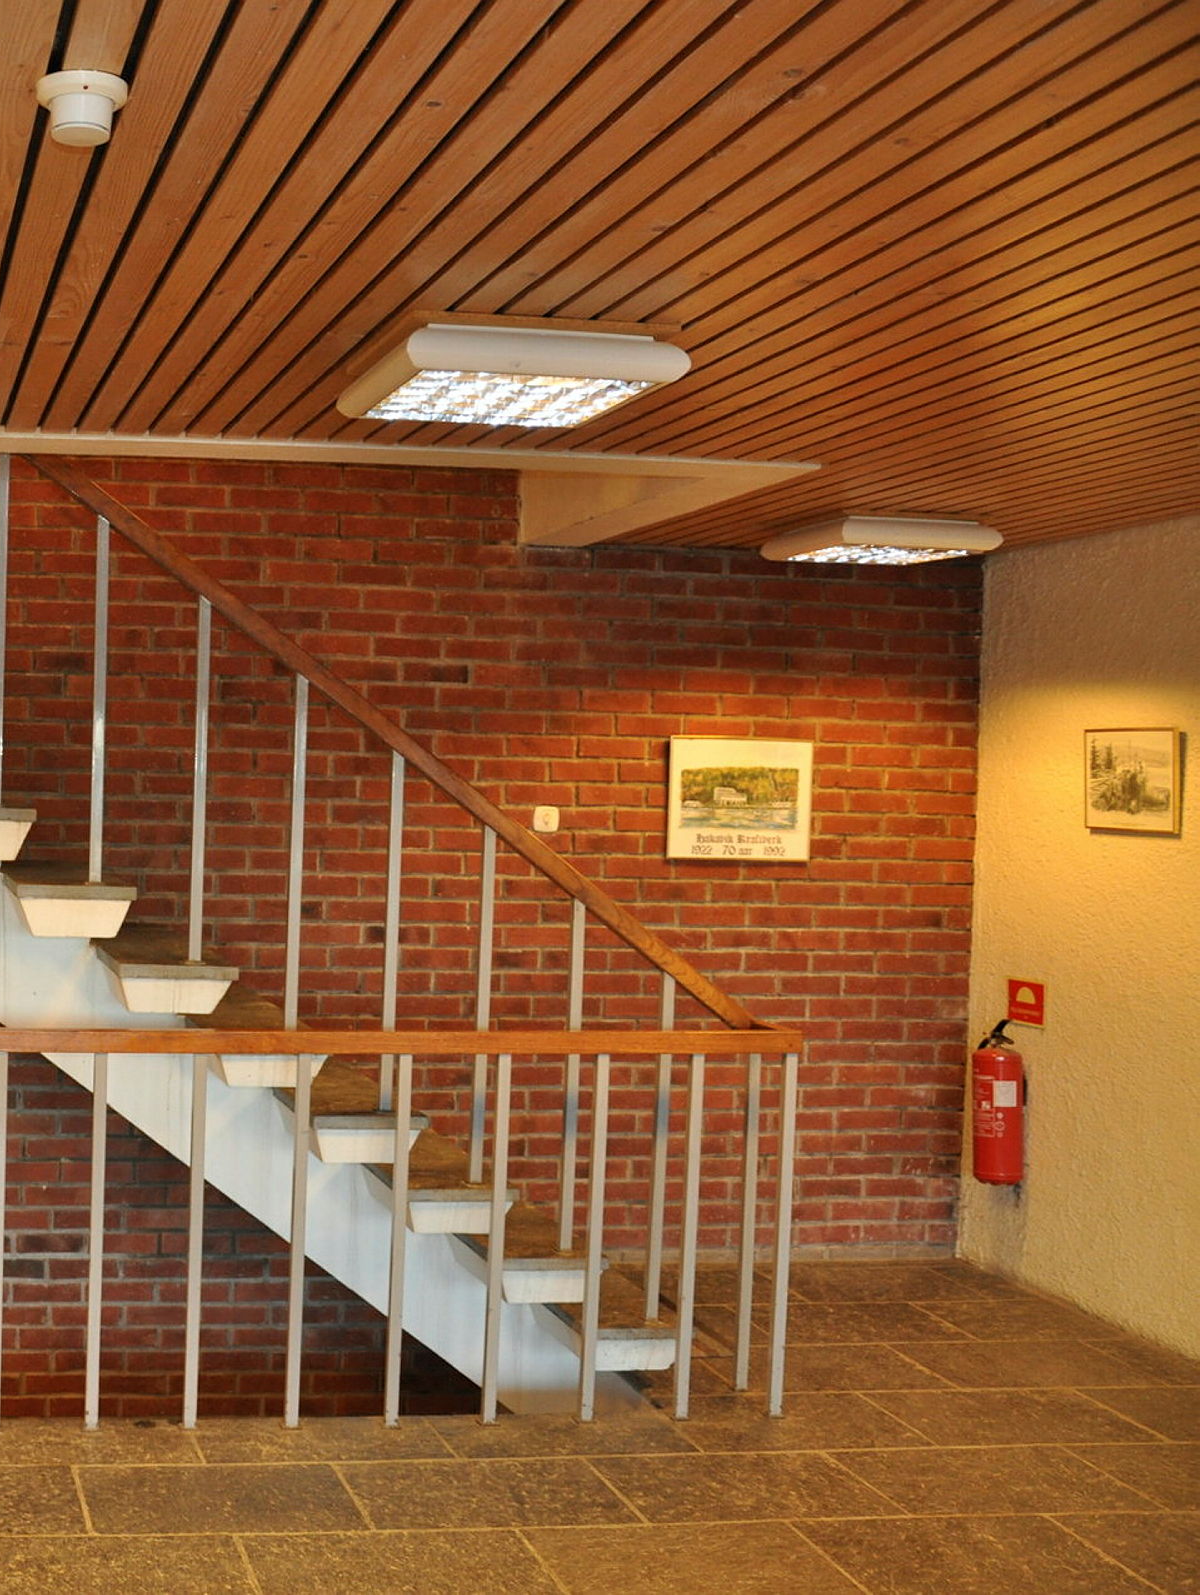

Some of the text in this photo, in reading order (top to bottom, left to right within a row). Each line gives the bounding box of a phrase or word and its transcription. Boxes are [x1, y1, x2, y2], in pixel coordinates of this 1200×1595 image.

[691, 845, 713, 856] 1922
[722, 844, 737, 856] 70
[763, 846, 786, 857] 1992
